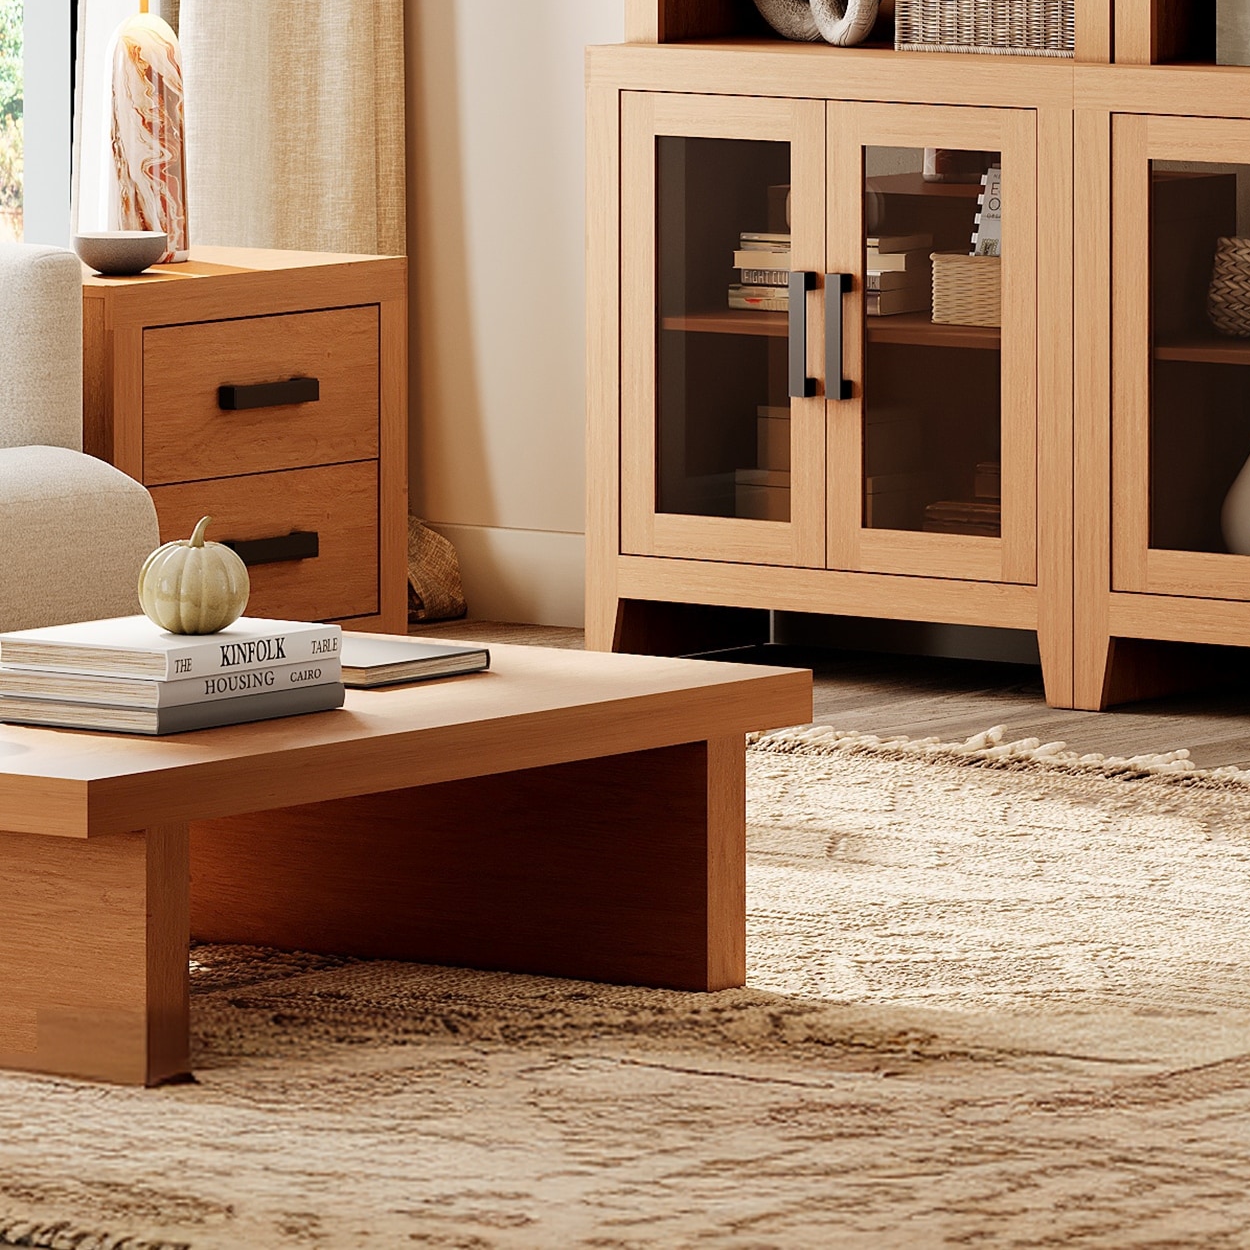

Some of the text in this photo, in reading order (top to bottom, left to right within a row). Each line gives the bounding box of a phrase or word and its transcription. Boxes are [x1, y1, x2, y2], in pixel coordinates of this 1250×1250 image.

[744, 270, 789, 286] FIGHT CLU
[175, 637, 338, 674] THE KINFOLK TABLE
[205, 668, 322, 695] HOUSING CAIRO
